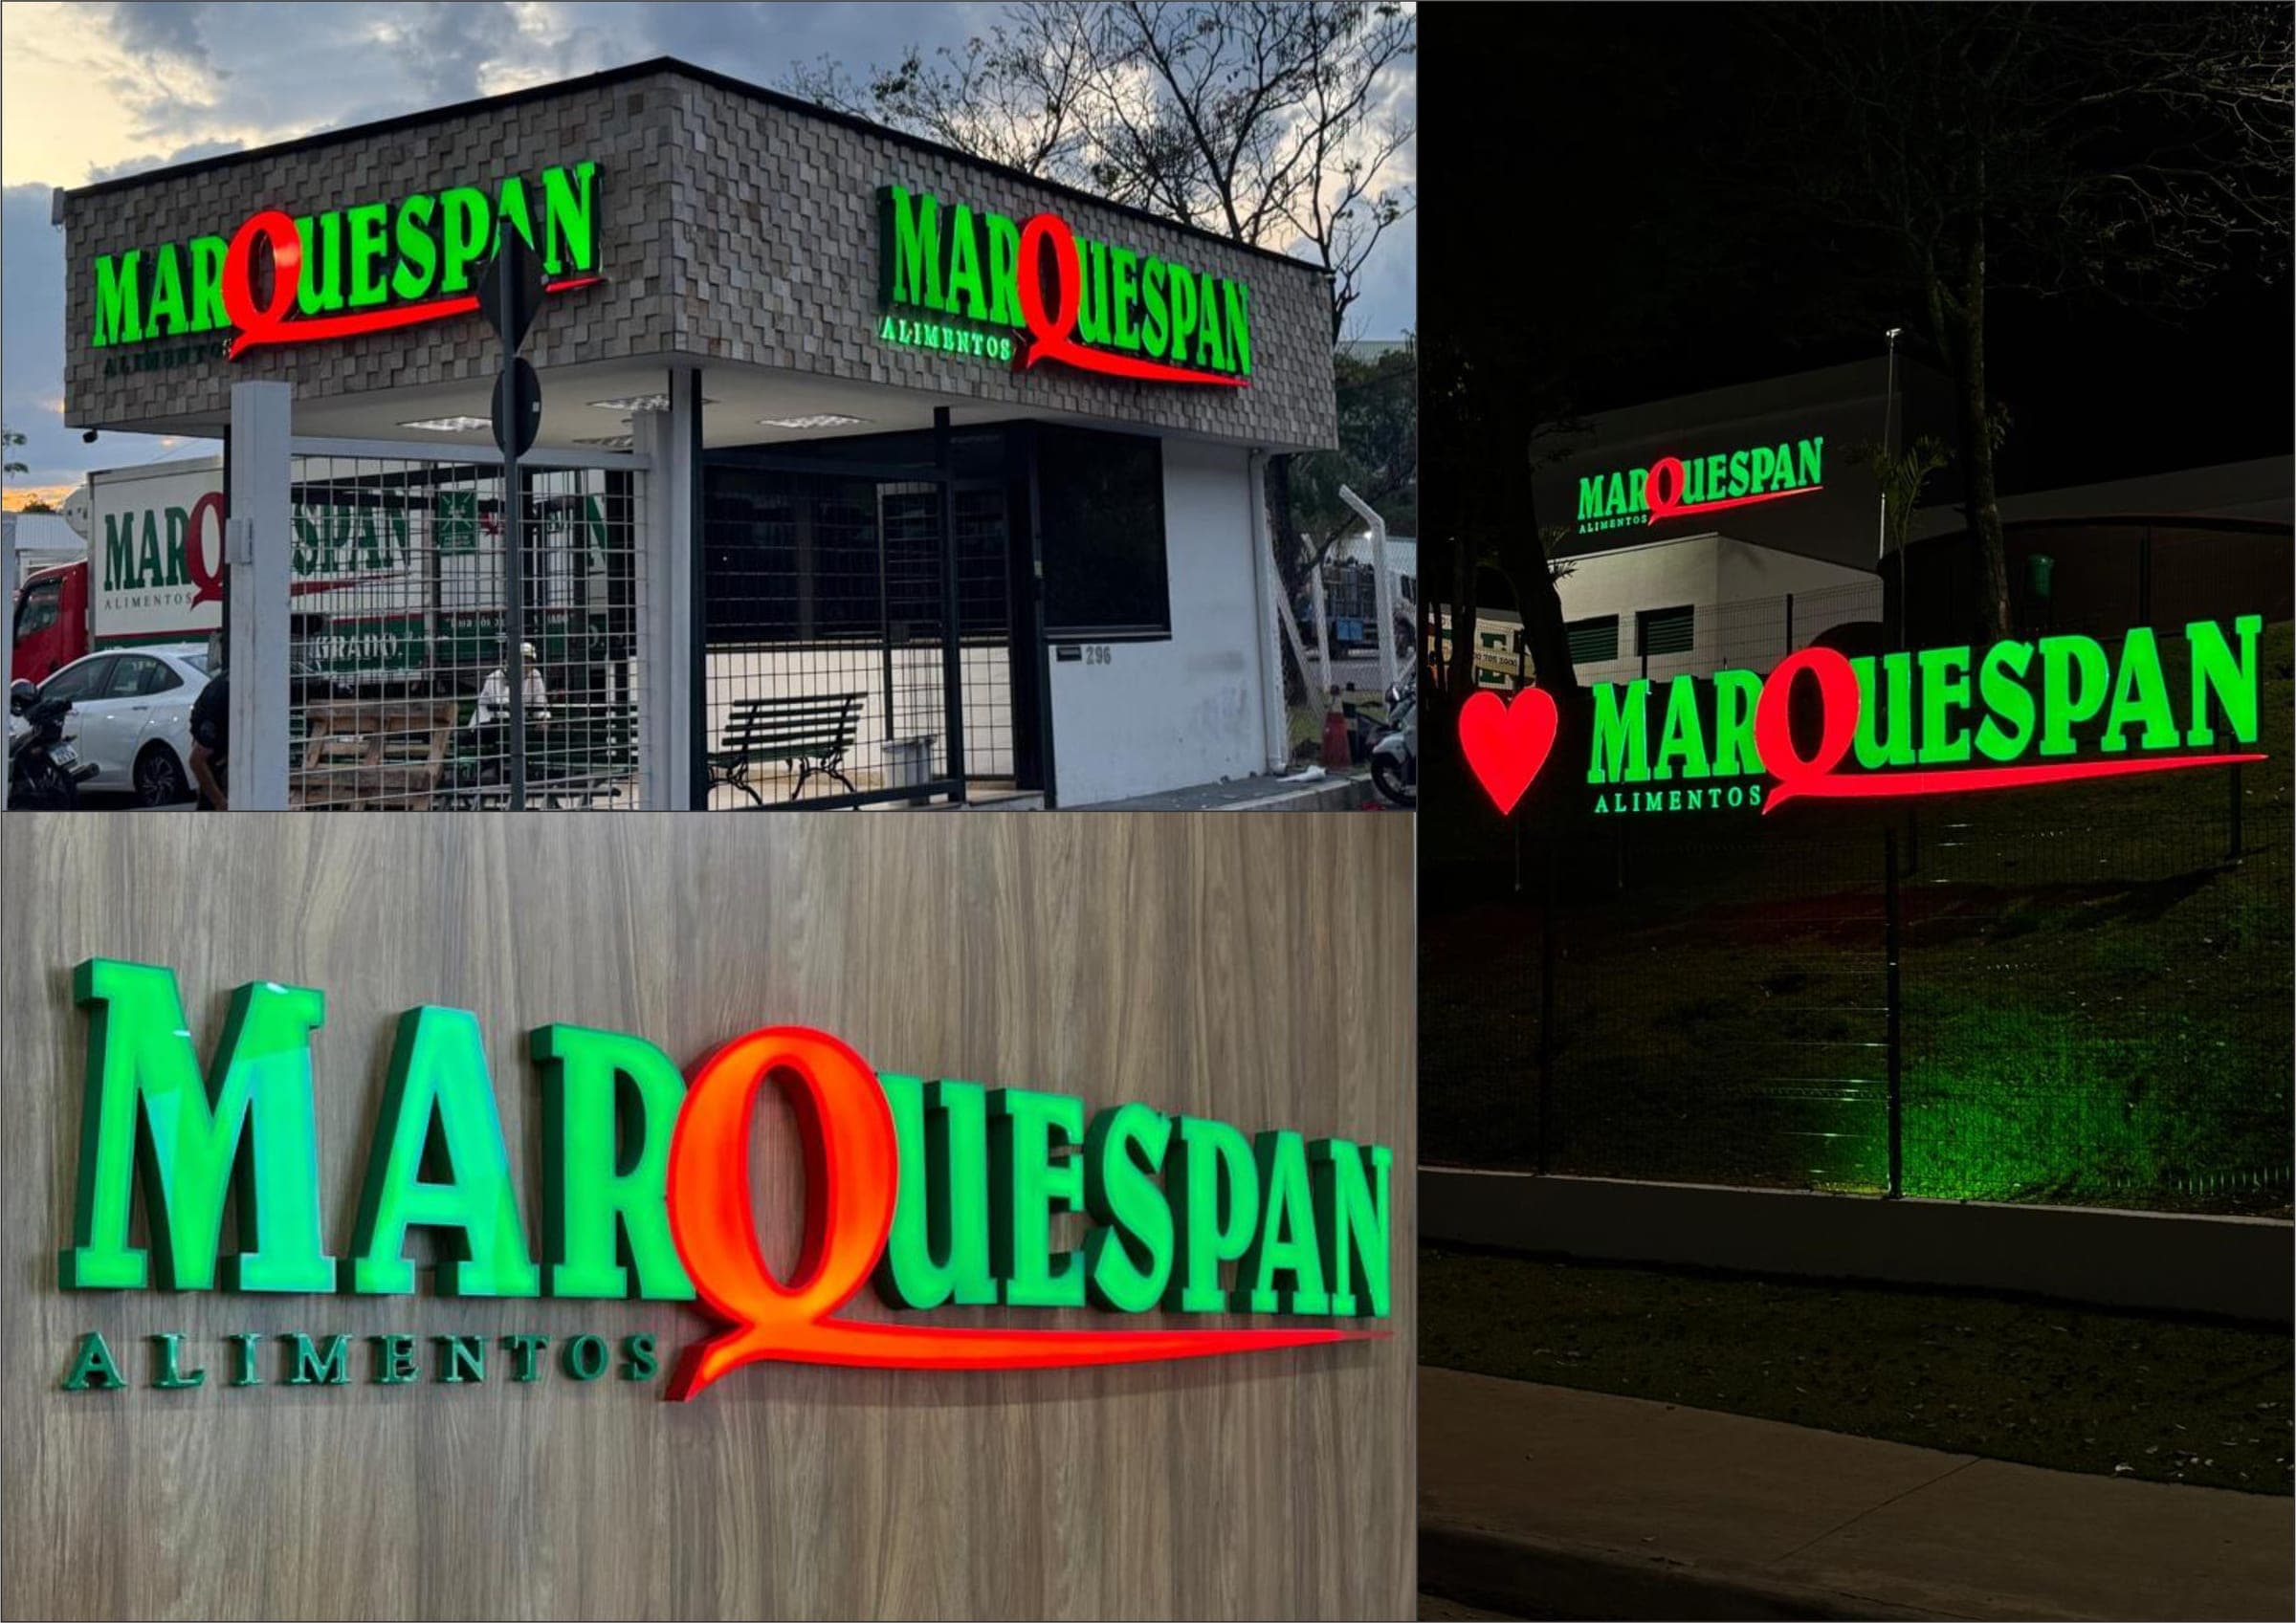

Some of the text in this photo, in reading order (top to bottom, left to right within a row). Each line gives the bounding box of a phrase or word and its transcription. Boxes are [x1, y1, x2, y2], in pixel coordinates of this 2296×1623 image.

[878, 186, 1251, 385] MARQUESPAN
[879, 318, 1012, 362] ALIMENTOS
[1577, 436, 1823, 526] MARQUESPAN
[1578, 515, 1648, 535] ALIMENTOS
[104, 593, 192, 610] ALIMENTOS
[1086, 646, 1112, 665] 296
[1586, 614, 2268, 815] MARQUESPAN
[1595, 784, 1762, 814] ALIMENTOS
[59, 956, 1394, 1402] MARQUESPAN
[62, 1330, 660, 1392] ALIMENTOS
